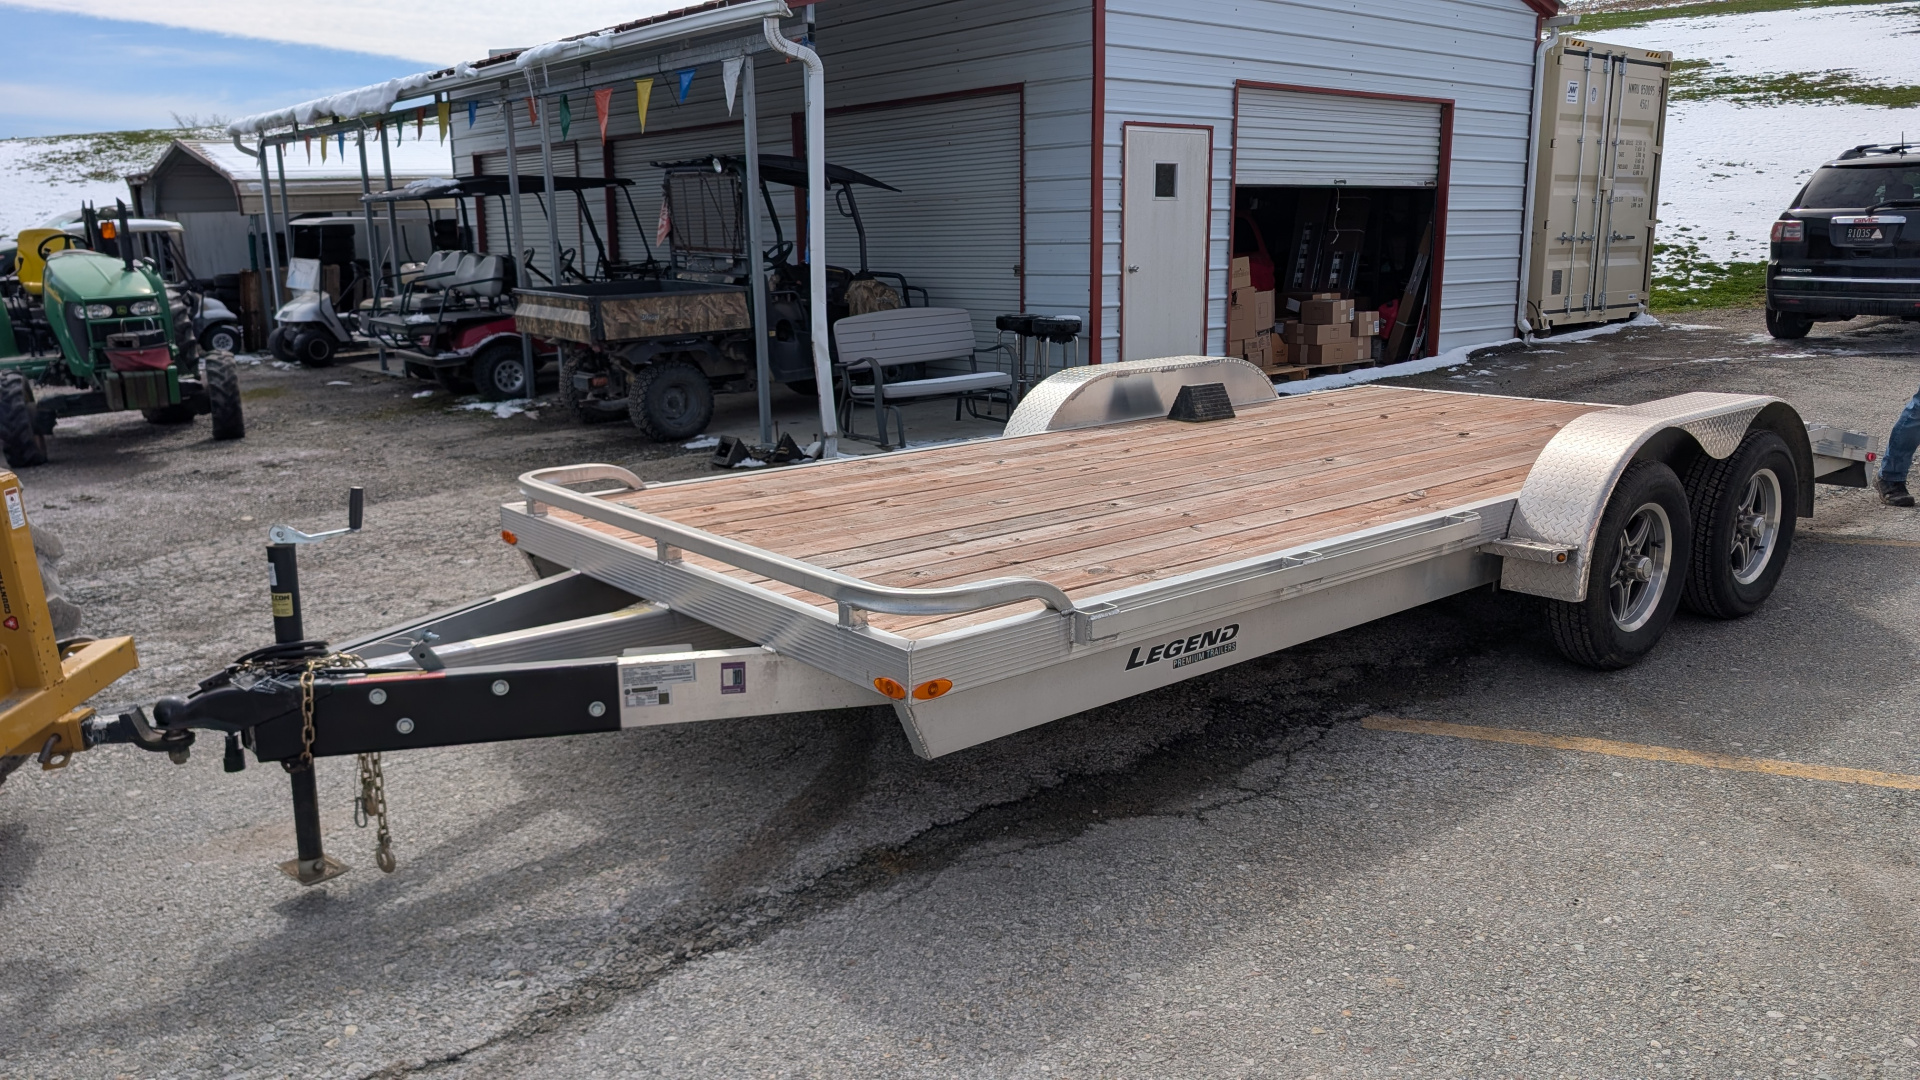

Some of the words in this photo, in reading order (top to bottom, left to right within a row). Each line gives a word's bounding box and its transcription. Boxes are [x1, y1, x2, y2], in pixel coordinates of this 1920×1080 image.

[1125, 623, 1240, 671] LEGEND
[1173, 652, 1205, 669] PREMIUM
[1206, 641, 1237, 659] TRAILERS
